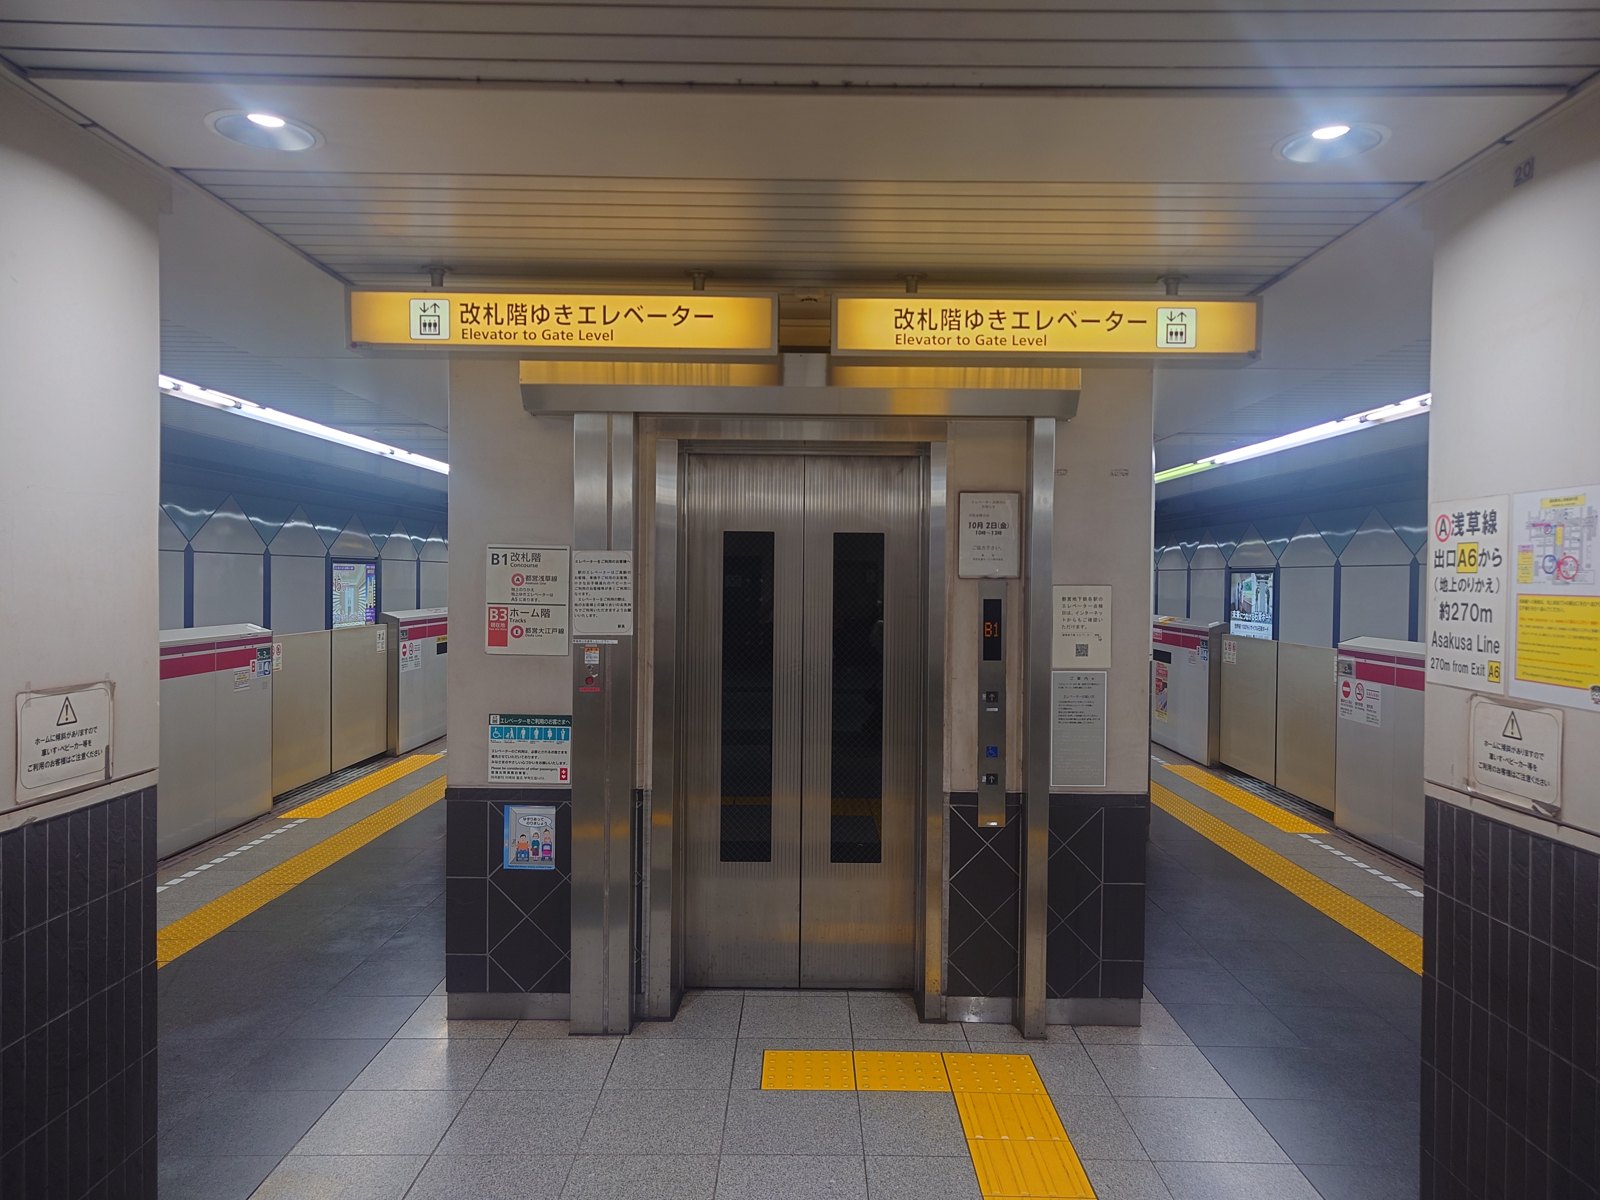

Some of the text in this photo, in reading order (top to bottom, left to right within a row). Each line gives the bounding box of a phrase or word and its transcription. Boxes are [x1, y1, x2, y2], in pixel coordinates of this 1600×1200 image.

[459, 302, 714, 327] 改札階ゆきエレベーター
[893, 307, 1147, 332] 改札階ゆきエレベーター
[461, 328, 614, 341] Elevator to Gate Level
[895, 333, 1047, 346] Elevator to Gate Level
[1438, 510, 1498, 537] A 浅草線
[491, 552, 542, 565] B1 改札階
[1434, 547, 1503, 569] 出口A6から
[489, 608, 551, 621] B3 ホーム階
[1439, 601, 1493, 623] 約270m
[985, 621, 999, 638] B1
[1431, 630, 1472, 656] Asakusa
[1477, 634, 1500, 654] Line
[1430, 658, 1500, 678] 270m from Exit A6
